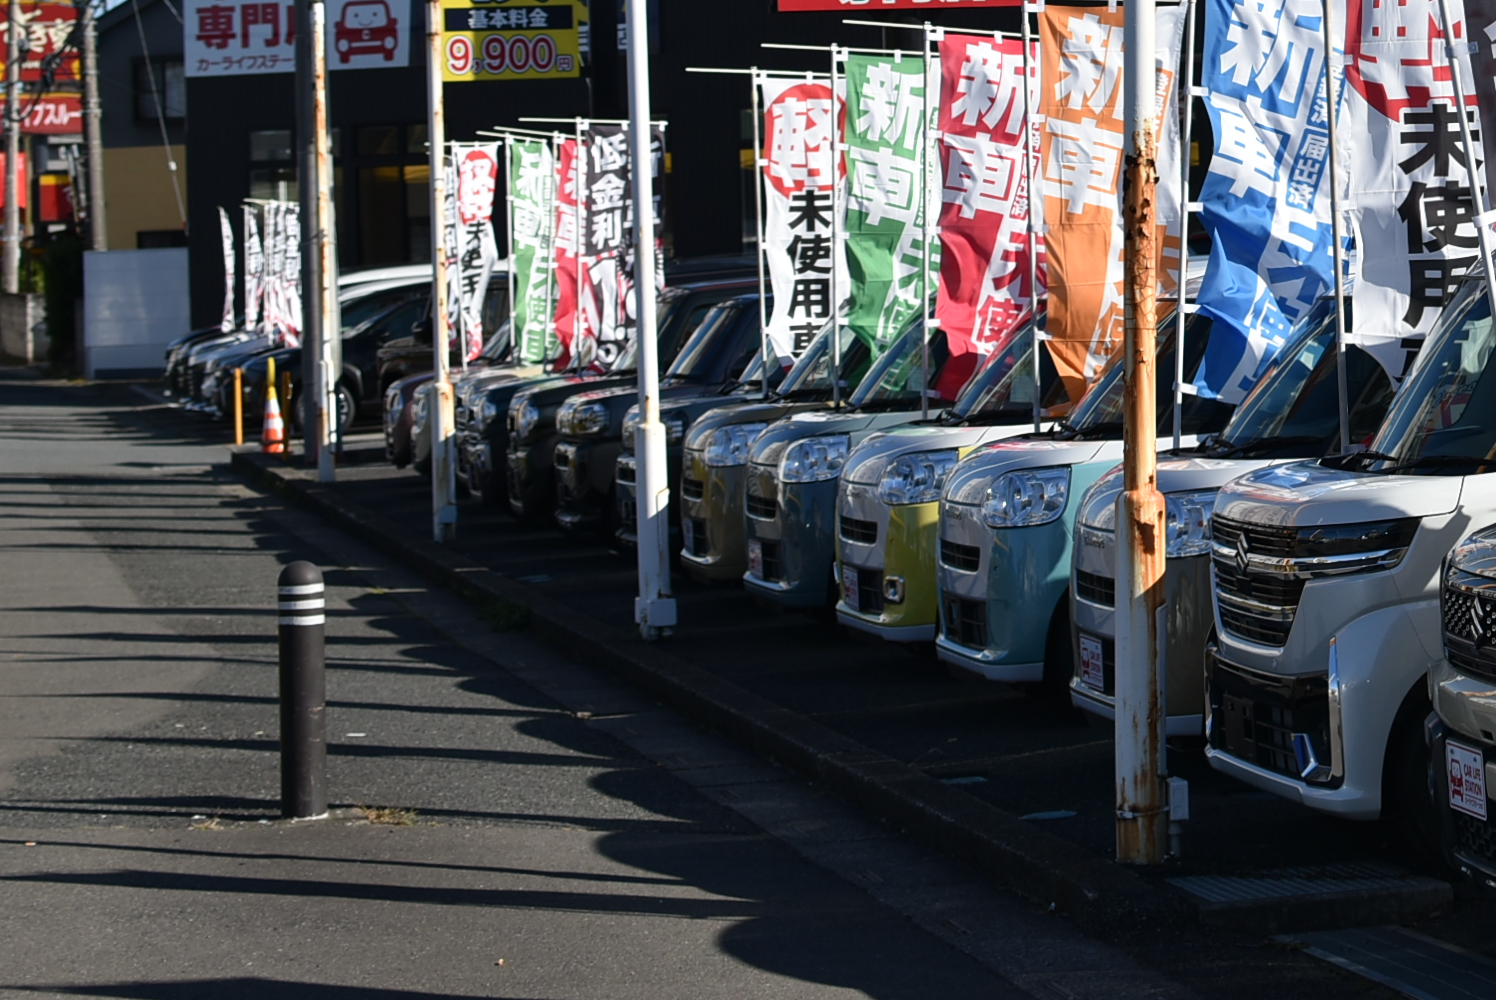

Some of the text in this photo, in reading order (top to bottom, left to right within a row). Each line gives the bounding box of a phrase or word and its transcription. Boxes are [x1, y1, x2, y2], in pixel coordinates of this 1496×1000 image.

[196, 2, 296, 50] 専門
[467, 9, 549, 29] 基本料金
[196, 55, 296, 71] カーライフステー
[847, 62, 926, 226] 新車
[943, 41, 1037, 220] 新車
[591, 133, 626, 250] 低金利
